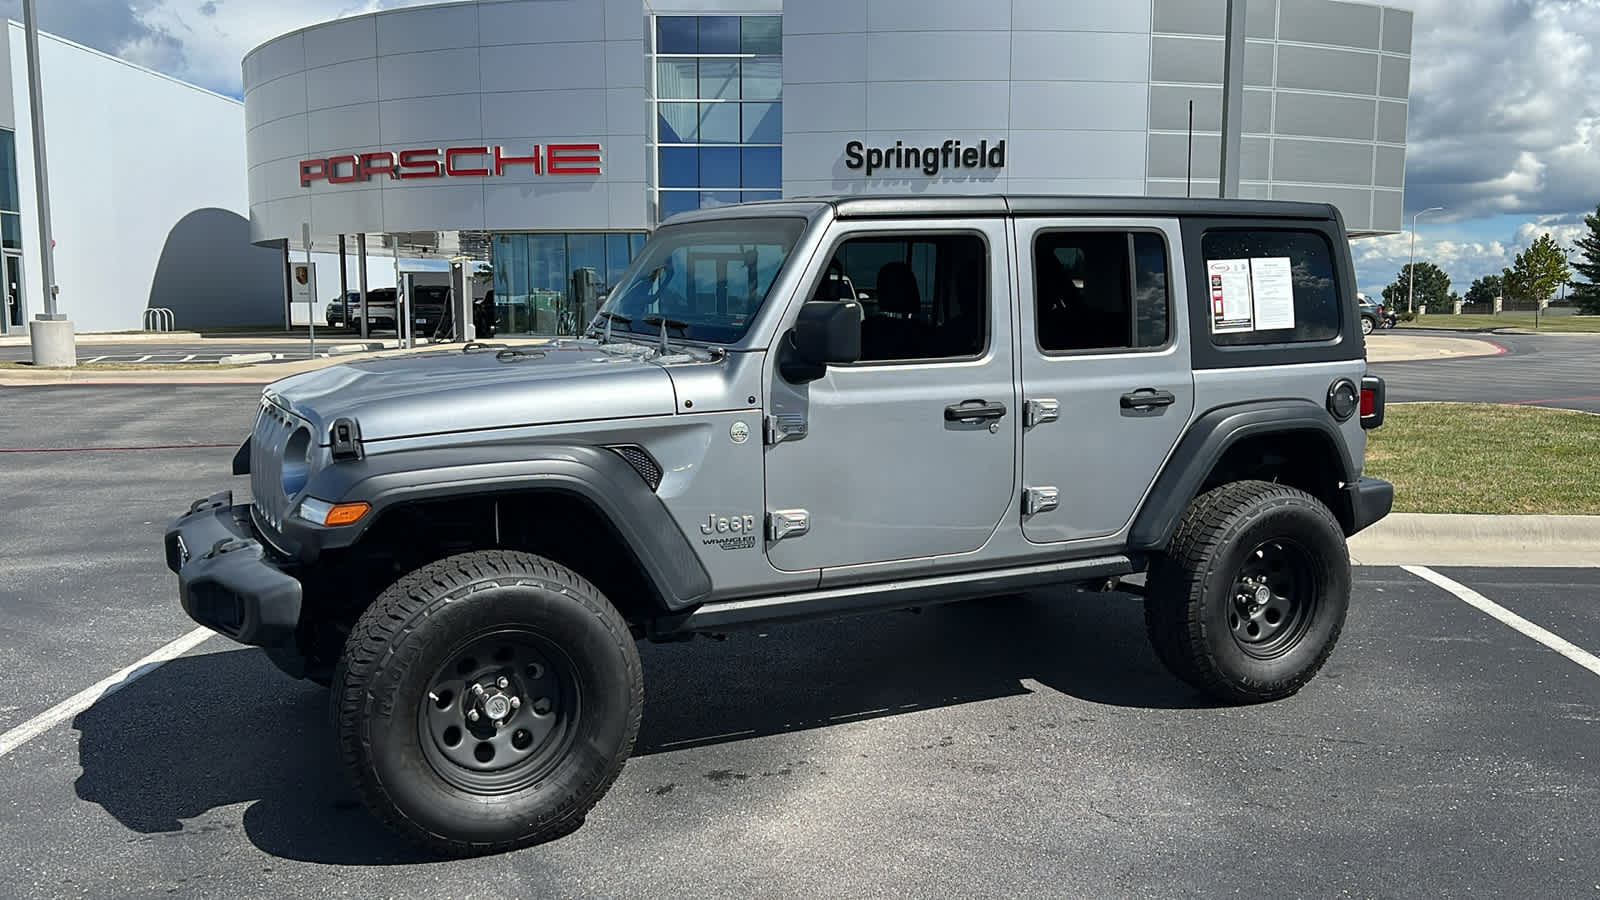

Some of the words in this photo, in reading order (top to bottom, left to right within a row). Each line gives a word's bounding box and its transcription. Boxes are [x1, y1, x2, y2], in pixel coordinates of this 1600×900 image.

[299, 143, 602, 188] PORSCHE
[845, 139, 1006, 176] Springfield
[700, 513, 755, 535] Jeep
